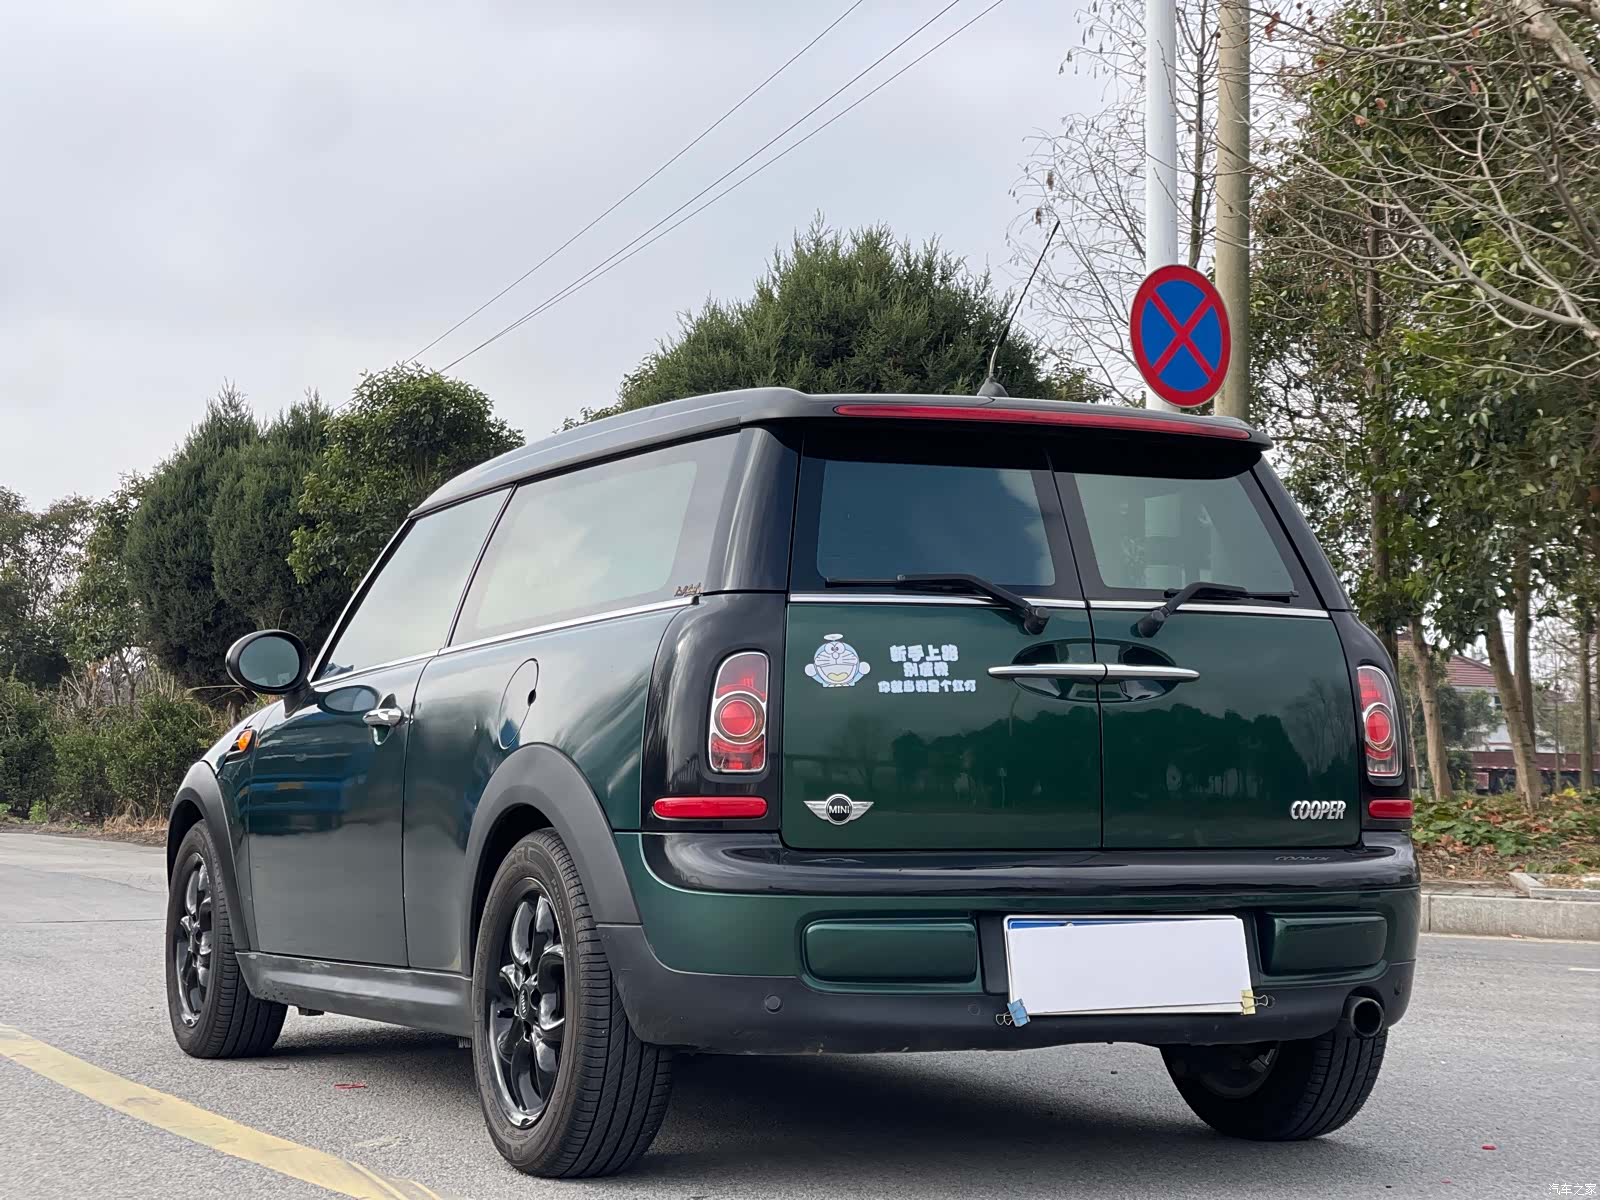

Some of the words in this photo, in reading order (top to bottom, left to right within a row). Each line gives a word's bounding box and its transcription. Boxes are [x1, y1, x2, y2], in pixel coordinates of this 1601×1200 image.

[889, 644, 959, 662] 新手上路
[828, 805, 850, 814] MINI
[1290, 800, 1347, 820] COOPER
